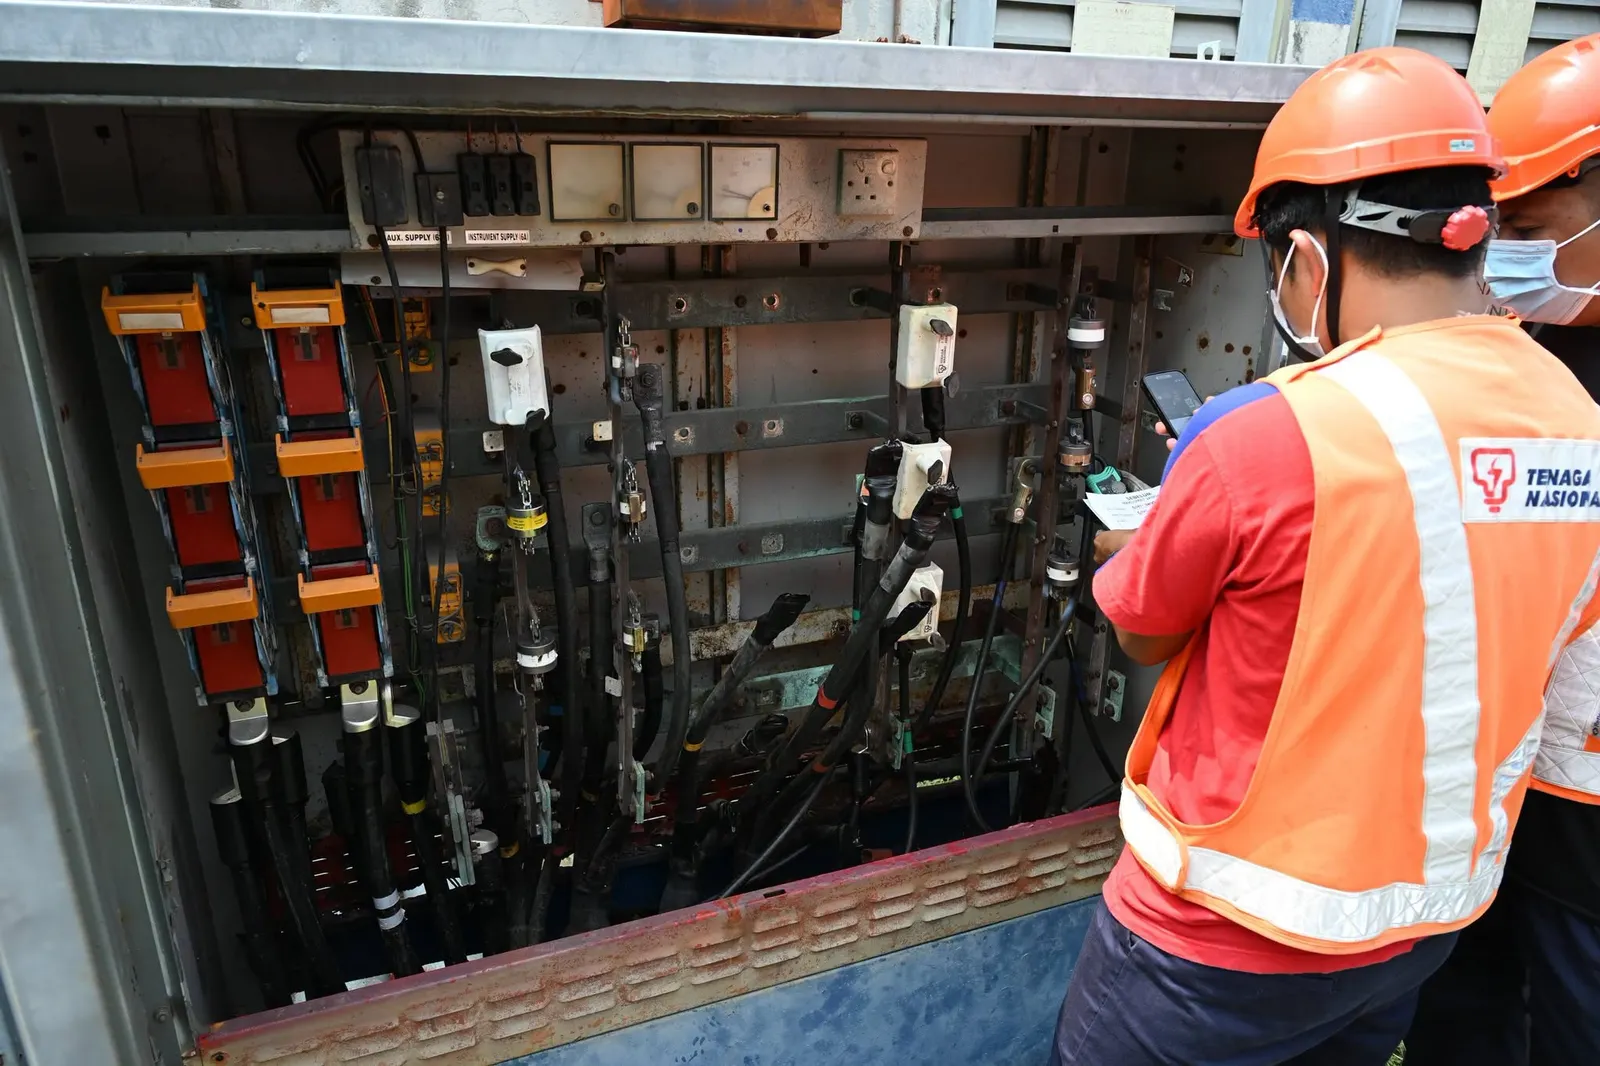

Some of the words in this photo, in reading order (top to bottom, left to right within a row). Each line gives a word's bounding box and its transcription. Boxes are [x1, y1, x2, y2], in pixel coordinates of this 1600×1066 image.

[405, 233, 431, 242] SUPPLY
[469, 232, 500, 241] INSTRUMENT
[500, 232, 518, 241] SUPPLY
[1527, 468, 1591, 486] TENAGA
